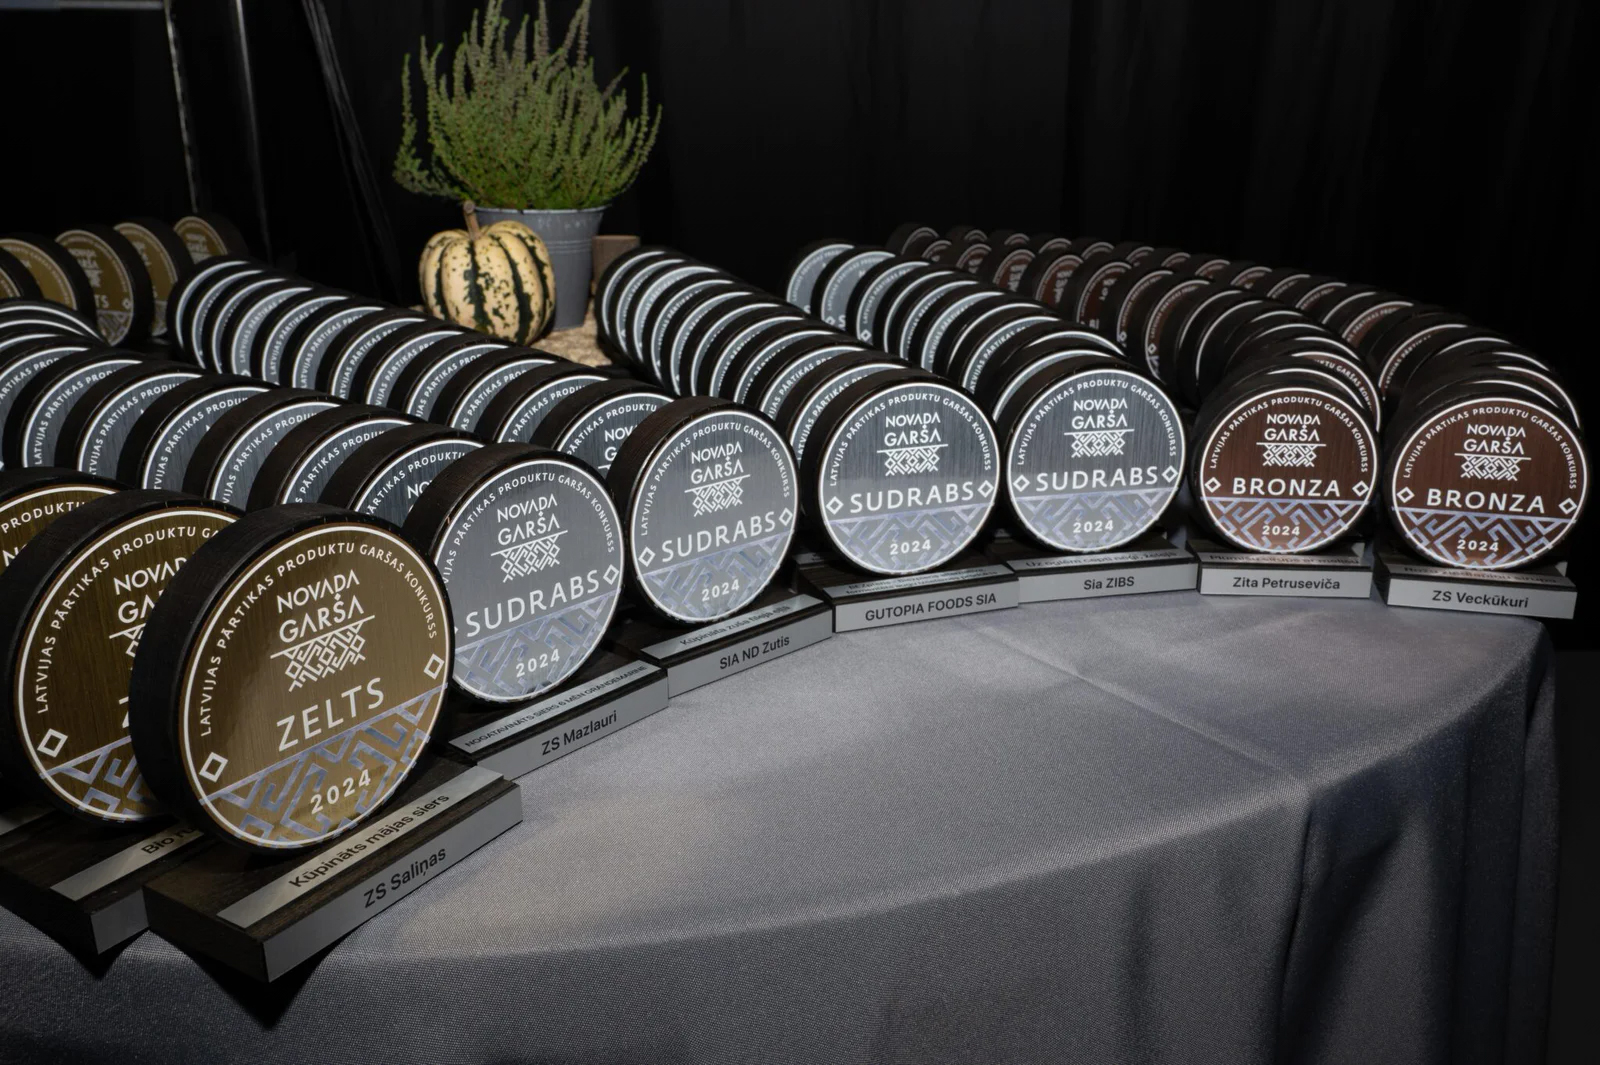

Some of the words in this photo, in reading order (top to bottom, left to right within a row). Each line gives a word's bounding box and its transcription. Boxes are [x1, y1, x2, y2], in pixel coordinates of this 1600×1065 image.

[339, 366, 353, 399] ATVIJAS
[351, 334, 382, 366] PĀRTIKAS
[375, 382, 388, 406] VIJAS
[384, 348, 418, 381] PĀRTIKAS
[424, 362, 458, 397] PĀRTIKAS
[467, 378, 502, 415] PĀRTIKAS
[606, 403, 657, 419] PRODUKTU
[1073, 397, 1128, 412] NOVADA
[34, 420, 49, 465] LATVIJAS
[45, 381, 84, 418] PĀRTIKAS
[512, 397, 549, 436] PĀRTIKAS
[885, 411, 941, 428] NOVADA
[1017, 422, 1037, 466] LATVIJAS
[1036, 387, 1075, 422] PĀRTIKAS
[1077, 378, 1129, 392] PRODUKTU
[1130, 384, 1161, 410] GARŠAS
[1158, 408, 1177, 457] KONKURSS
[1071, 409, 1128, 430] GARŠA
[1264, 424, 1320, 442] GARŠA
[1266, 413, 1321, 426] NOVADA
[1466, 423, 1527, 438] NOVADA
[89, 438, 104, 475] TVIJAS
[100, 396, 139, 436] PĀRTIKAS
[154, 456, 168, 490] TVIJAS
[165, 411, 204, 454] PĀRTIKAS
[829, 440, 848, 487] LATVIJAS
[846, 402, 886, 440] PĀRTIKAS
[888, 392, 941, 407] PRODUKTU
[942, 397, 974, 424] GARŠAS
[971, 421, 992, 471] KONKURSS
[884, 424, 942, 447] GARŠA
[1210, 430, 1231, 469] LATVIJAS
[1228, 402, 1269, 430] PĀRTIKAS
[1271, 396, 1323, 408] PRODUKTU
[1324, 403, 1353, 429] GARŠAS
[1351, 427, 1369, 473] KONKURSS
[1402, 439, 1427, 479] LATVIJAS
[1426, 411, 1470, 440] PĀRTIKAS
[1472, 406, 1530, 419] PRODUKTU
[1530, 414, 1563, 443] GARŠAS
[1559, 441, 1577, 490] KONKURSS
[1463, 436, 1525, 455] GARŠA
[222, 474, 237, 503] VIJAS
[233, 428, 273, 472] PĀRTIKAS
[300, 447, 340, 494] PĀRTIKAS
[690, 456, 744, 485] GARŠA
[691, 441, 743, 465] NOVADA
[366, 470, 406, 515] ĀRTIKAS
[640, 485, 657, 536] LATVIJAS
[655, 437, 691, 482] PĀRTIKAS
[693, 422, 741, 441] PRODUKTU
[743, 425, 772, 449] GARŠAS
[770, 447, 790, 498] KONKURSS
[1035, 466, 1158, 492] SUDRABS
[1232, 477, 1341, 498] BRONZA
[497, 494, 558, 523] NOVADA
[850, 481, 974, 513] SUDRABS
[1426, 488, 1546, 514] BRONZA
[443, 550, 457, 585] VIJAS
[454, 492, 496, 546] PĀRTIKAS
[498, 472, 555, 496] PRODUKTU
[558, 475, 592, 500] GARŠAS
[590, 498, 615, 553] KONKURSS
[497, 511, 560, 546] GARŠA
[661, 511, 776, 563] SUDRABS
[1072, 520, 1114, 534] 2024
[1262, 524, 1301, 536] 2024
[889, 539, 932, 555] 2024
[1456, 539, 1500, 552] 2024
[276, 569, 360, 613] NOVADA
[701, 579, 740, 602] 2024
[1083, 578, 1103, 591] Sia
[1106, 576, 1135, 589] ZIBS
[1232, 576, 1259, 589] Zita
[1262, 576, 1341, 591] Petruseviča
[1432, 589, 1452, 602] ZS
[1456, 592, 1529, 609] Veckūkuri
[36, 636, 56, 714] LATVIJAS
[51, 558, 110, 630] PĀRTIKAS
[113, 526, 196, 559] PRODUKTU
[279, 594, 364, 643] GARŠA
[466, 569, 600, 638] SUDRABS
[865, 602, 925, 622] GUTOPIA
[927, 596, 973, 613] FOODS
[975, 592, 998, 605] SIA
[201, 655, 221, 736] LATVIJAS
[217, 575, 274, 649] PĀRTIKAS
[277, 542, 355, 576] PRODUKTU
[359, 544, 405, 573] GARŠAS
[405, 570, 437, 639] KONKURSS
[719, 653, 740, 670] SIA
[742, 645, 760, 661] ND
[762, 635, 790, 655] Zutis
[515, 648, 561, 678] 2024
[276, 677, 384, 752] ZELTS
[541, 736, 561, 756] ZS
[563, 709, 618, 745] Mazlauri
[310, 769, 371, 815] 2024
[141, 837, 175, 854] Bio
[288, 841, 367, 888] Kūpināts
[367, 814, 414, 848] mājas
[412, 793, 450, 819] siers
[363, 882, 387, 908] ZS
[390, 848, 447, 890] Saliņas
